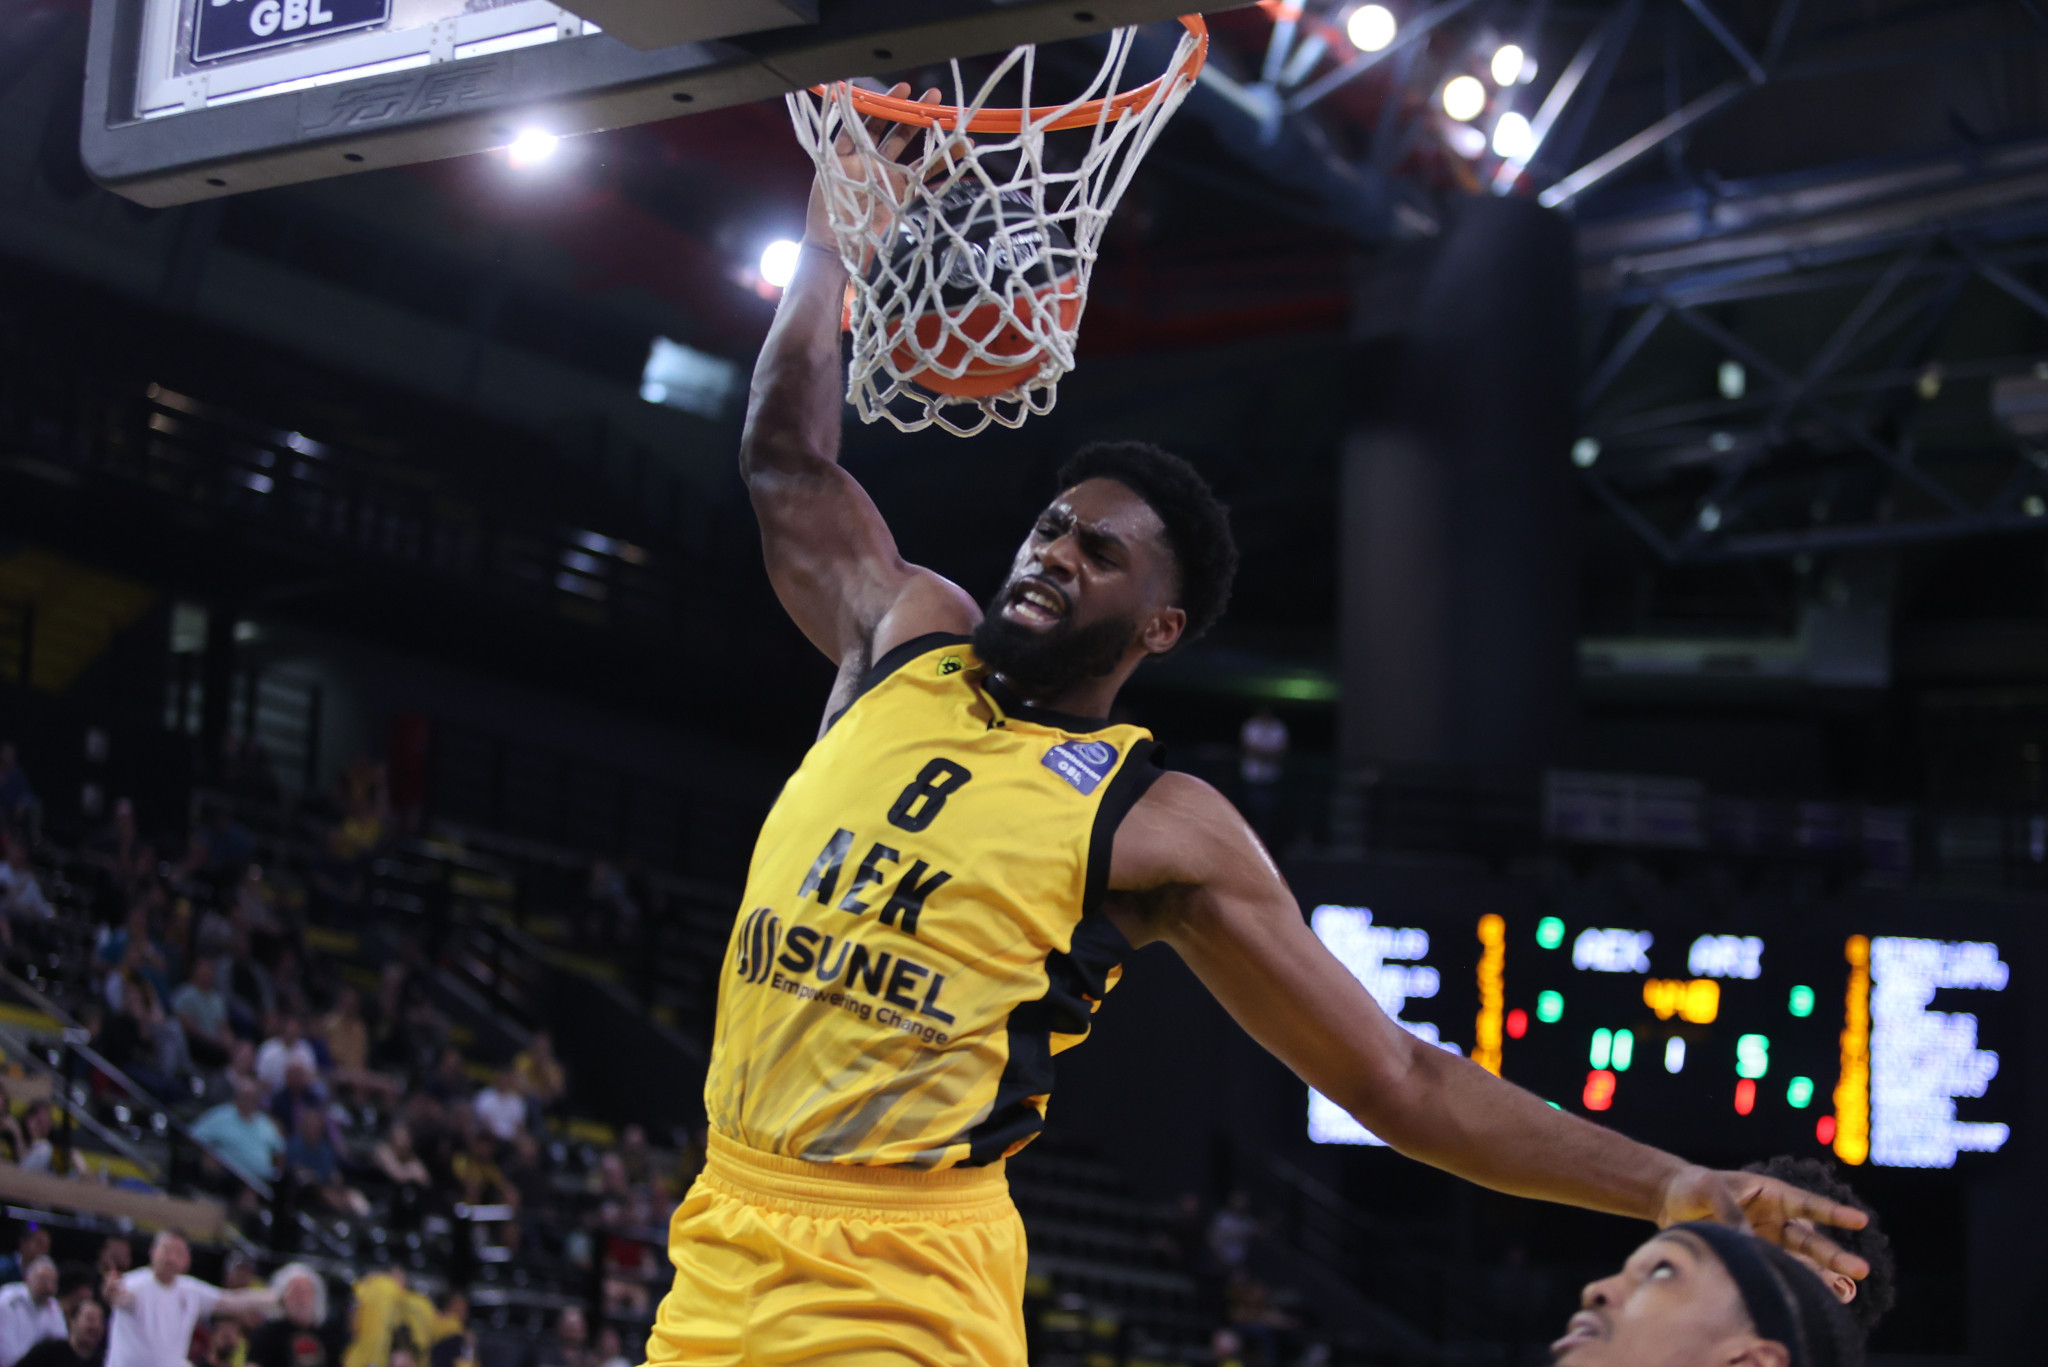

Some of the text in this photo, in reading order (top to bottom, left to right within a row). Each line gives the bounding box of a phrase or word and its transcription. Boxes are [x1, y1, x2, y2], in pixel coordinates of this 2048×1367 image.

[250, 0, 333, 37] GBL
[887, 757, 972, 834] 8
[797, 827, 952, 936] AEK
[778, 925, 956, 1026] SUNEL
[875, 1006, 949, 1045] Change
